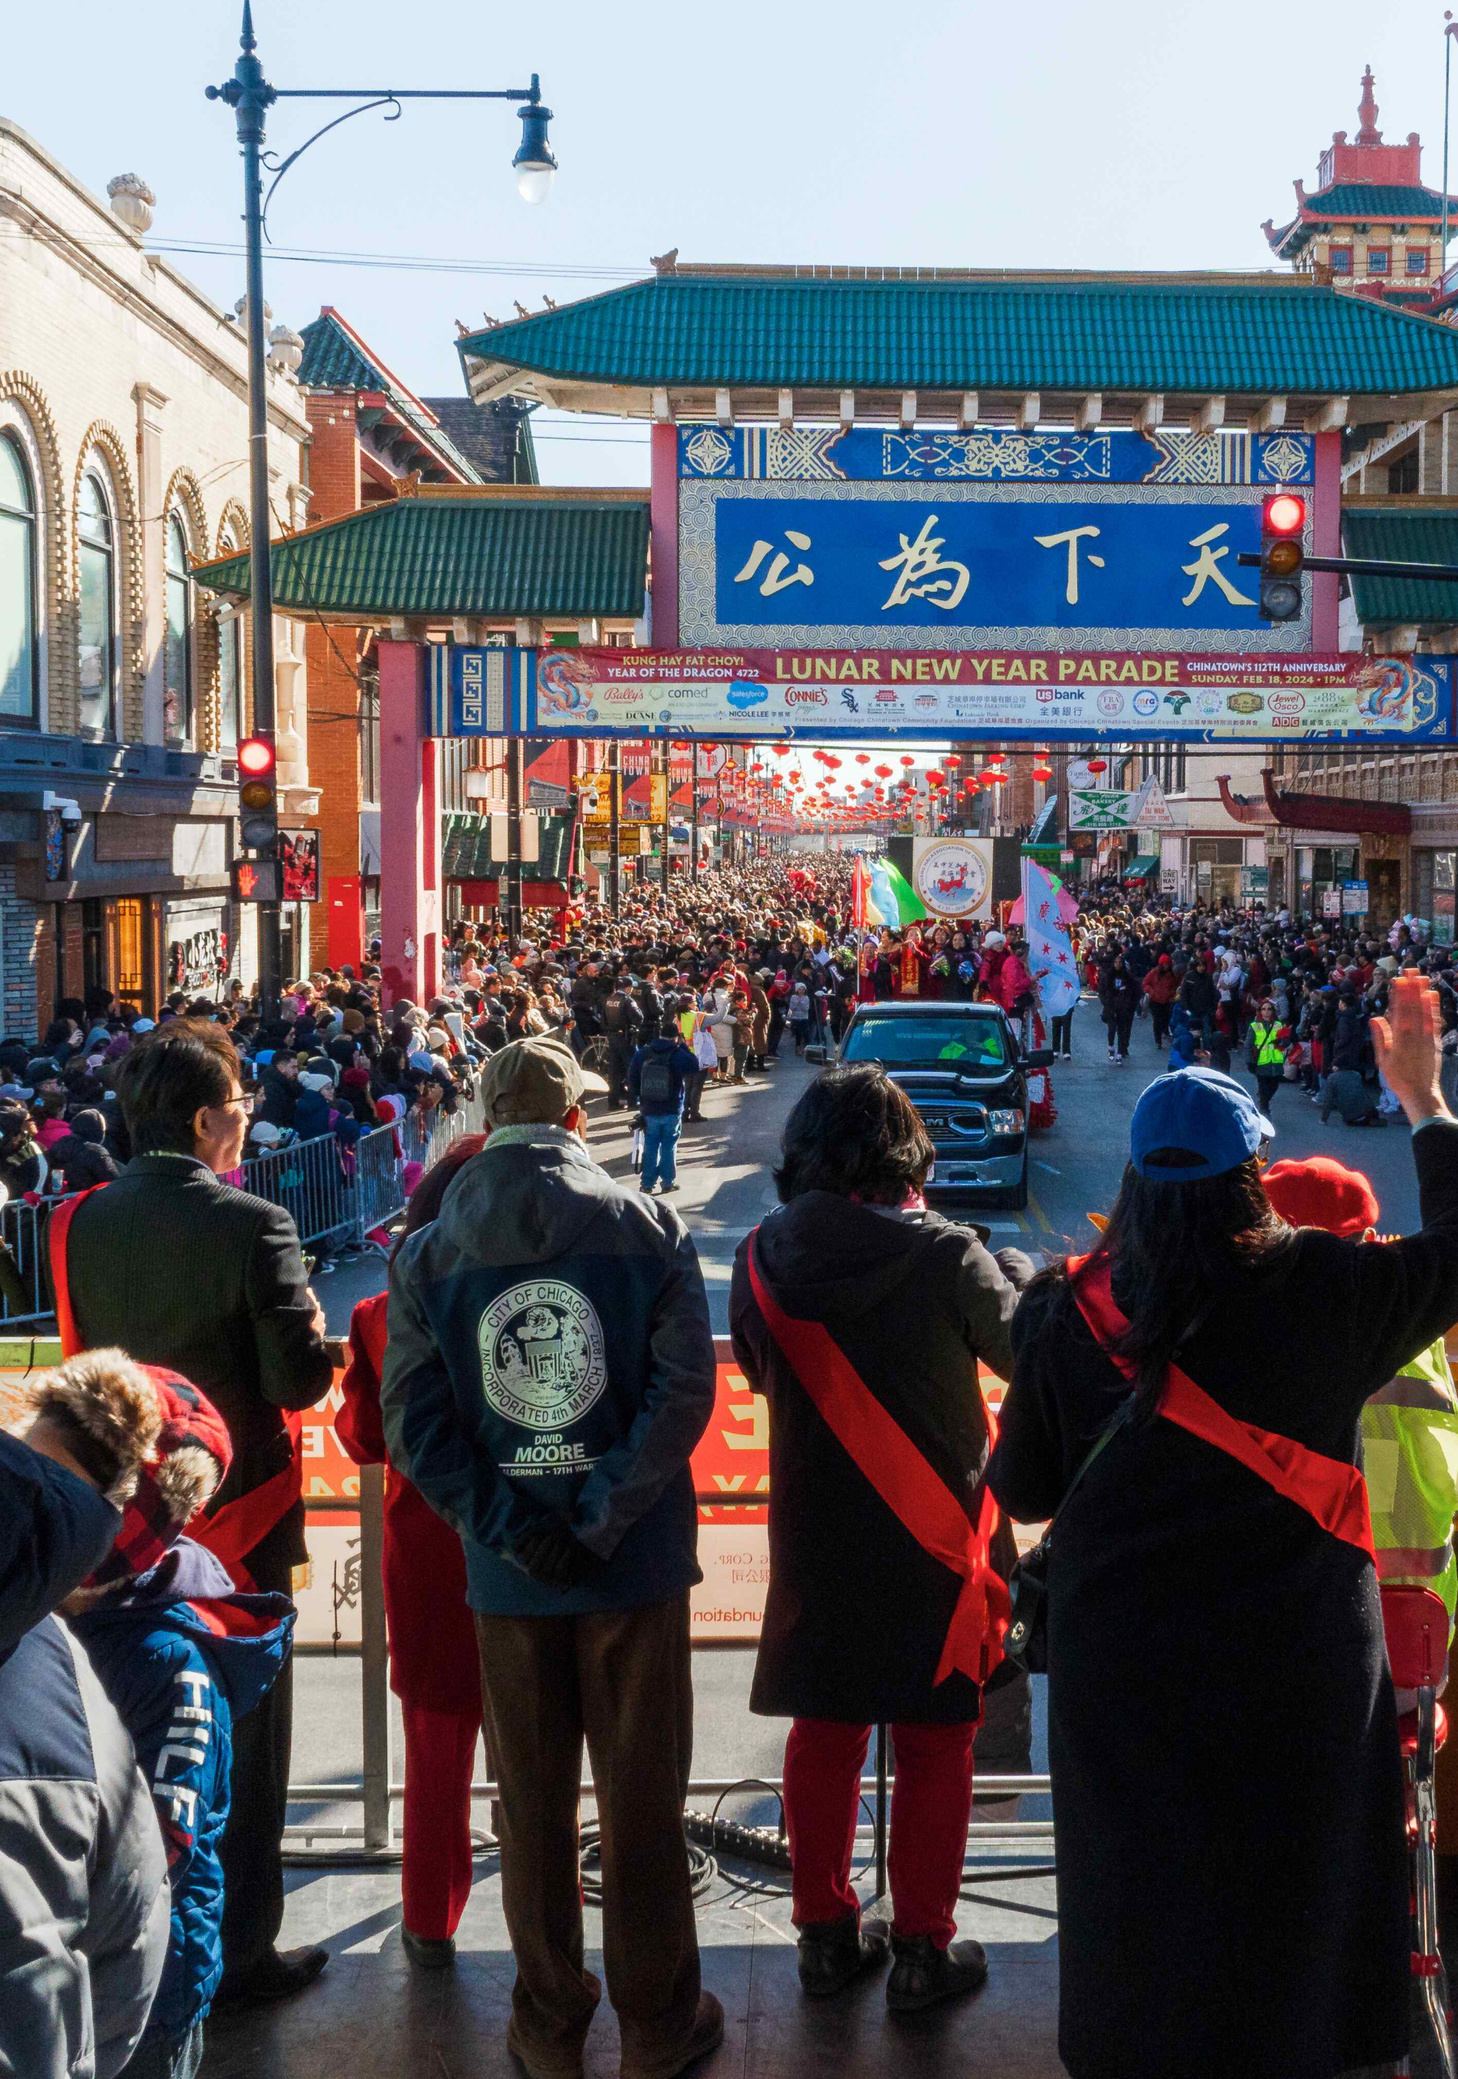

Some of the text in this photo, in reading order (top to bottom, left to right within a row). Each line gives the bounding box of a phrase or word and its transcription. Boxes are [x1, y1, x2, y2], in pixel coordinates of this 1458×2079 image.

[622, 656, 744, 666] KUNG HAY FAT CHOY!
[775, 657, 1179, 682] LUNAR NEW YEAR PARADE
[1186, 662, 1347, 672] CHINATOWN'S 112TH ANNIVERSARY
[607, 668, 760, 678] YEAR OF THE DRAGON 4722
[1191, 674, 1240, 684] SUNDAY,
[1243, 675, 1265, 684] FEB.
[1285, 675, 1314, 684] 2024
[1324, 676, 1346, 684] 1PM
[604, 687, 644, 702] Bally's
[667, 687, 709, 699] comed
[732, 690, 765, 698] salesforce
[1322, 692, 1336, 702] 88
[1273, 695, 1300, 703] Jewel
[1272, 717, 1299, 727] ADG
[623, 767, 649, 776] TOWN
[672, 776, 692, 784] TOWN
[488, 1286, 590, 1329] CITY OF CHICAGO
[481, 1334, 603, 1424] INCORPORATED 4th MARCH 1837
[534, 1433, 563, 1445] DAVID
[514, 1443, 585, 1463] MOORE
[553, 1466, 573, 1474] 17TH
[575, 1463, 598, 1472] WAR
